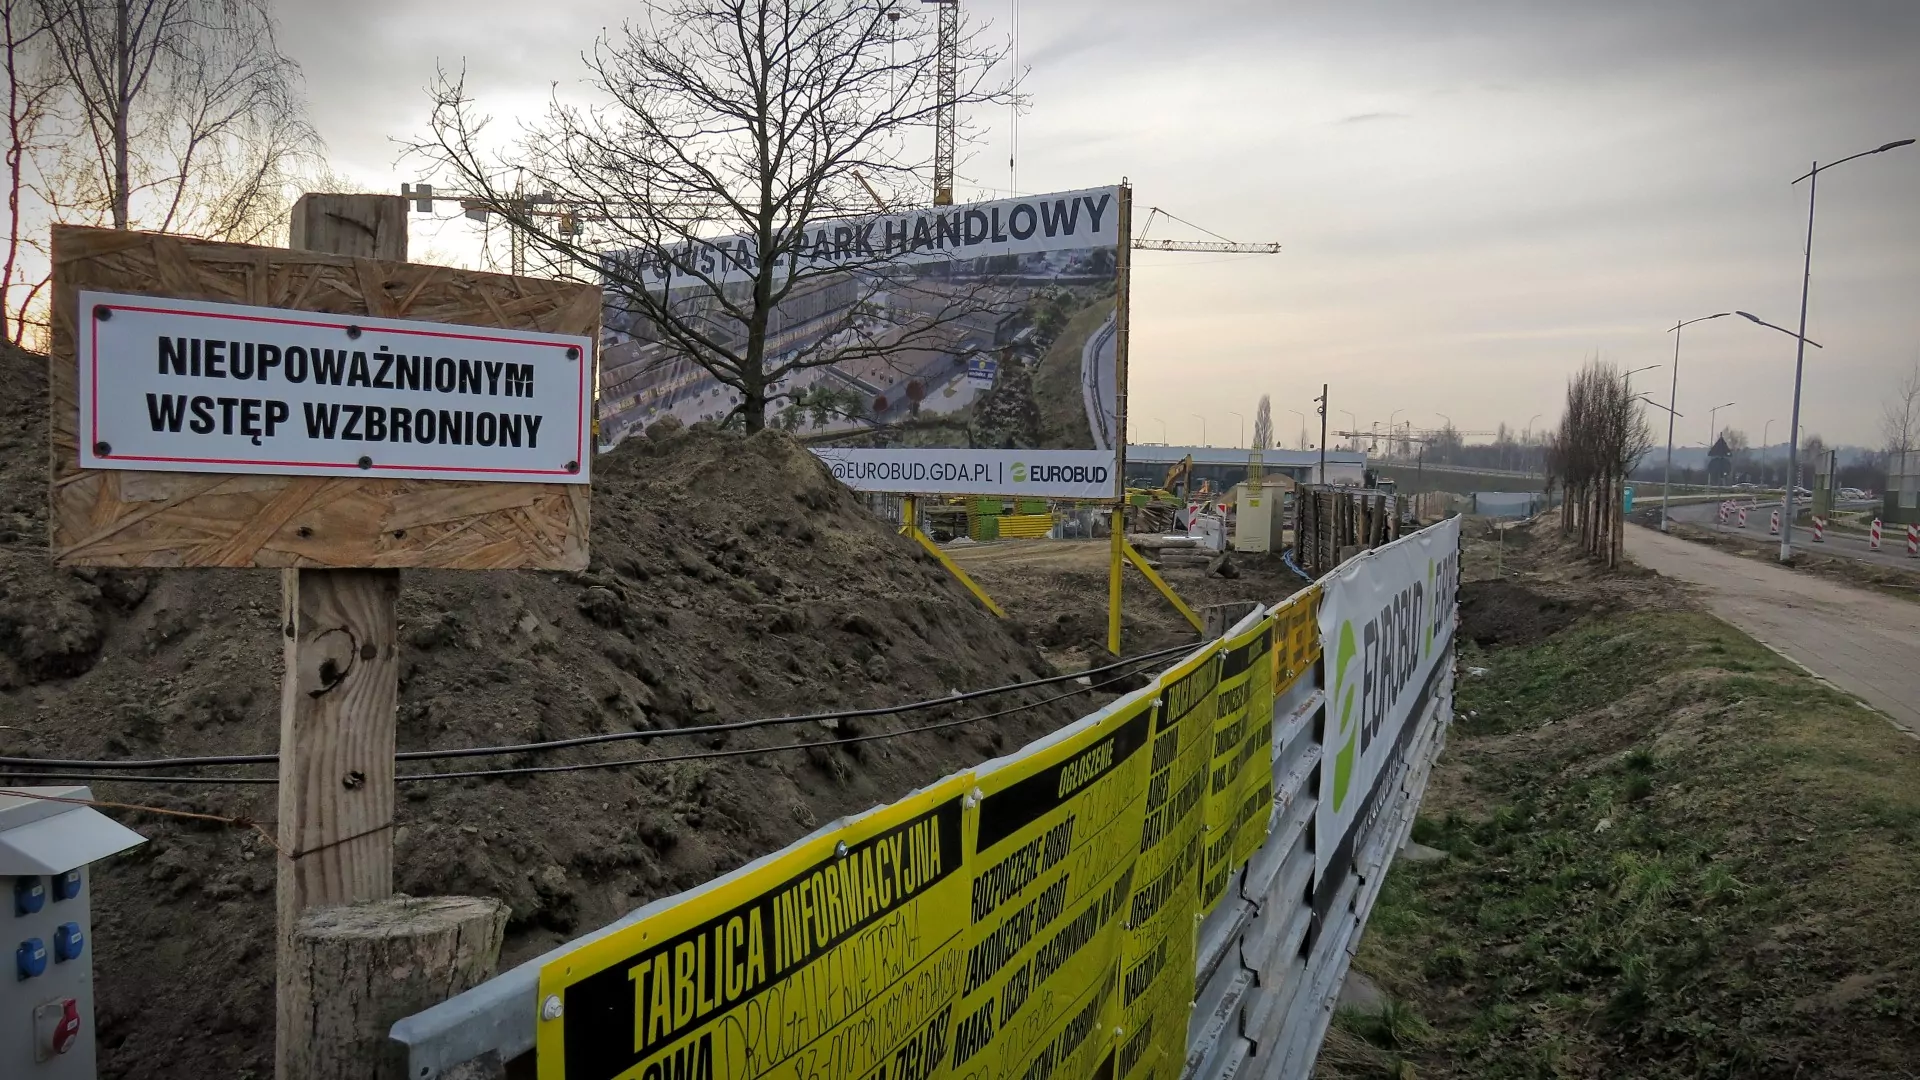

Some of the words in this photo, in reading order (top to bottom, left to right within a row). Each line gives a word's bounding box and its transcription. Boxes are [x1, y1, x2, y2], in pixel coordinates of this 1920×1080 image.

[800, 221, 875, 262] PARK
[885, 194, 1111, 253] HANDLOWY
[157, 335, 535, 398] NIEUPOWAŻNIONYM
[146, 392, 289, 446] WSTĘP
[303, 402, 542, 449] WZBRONIONY
[1030, 465, 1108, 483] EUROBUD
[1360, 580, 1424, 757] EUROBUD
[1057, 738, 1114, 799] OGŁOSZENIE
[971, 834, 1043, 926] ROZPOCZĘCIE
[1042, 809, 1076, 874] ROBÓT
[628, 905, 766, 1054] TABLICA
[772, 815, 941, 975] INFORMACYJNA
[962, 897, 1037, 999] ZAKOŃCZENIE
[1035, 869, 1069, 935] ROBÓT
[952, 997, 995, 1071] MAKS.
[1000, 959, 1031, 1031] LICZBA
[1032, 897, 1100, 992] PRACOWNIKÓW
